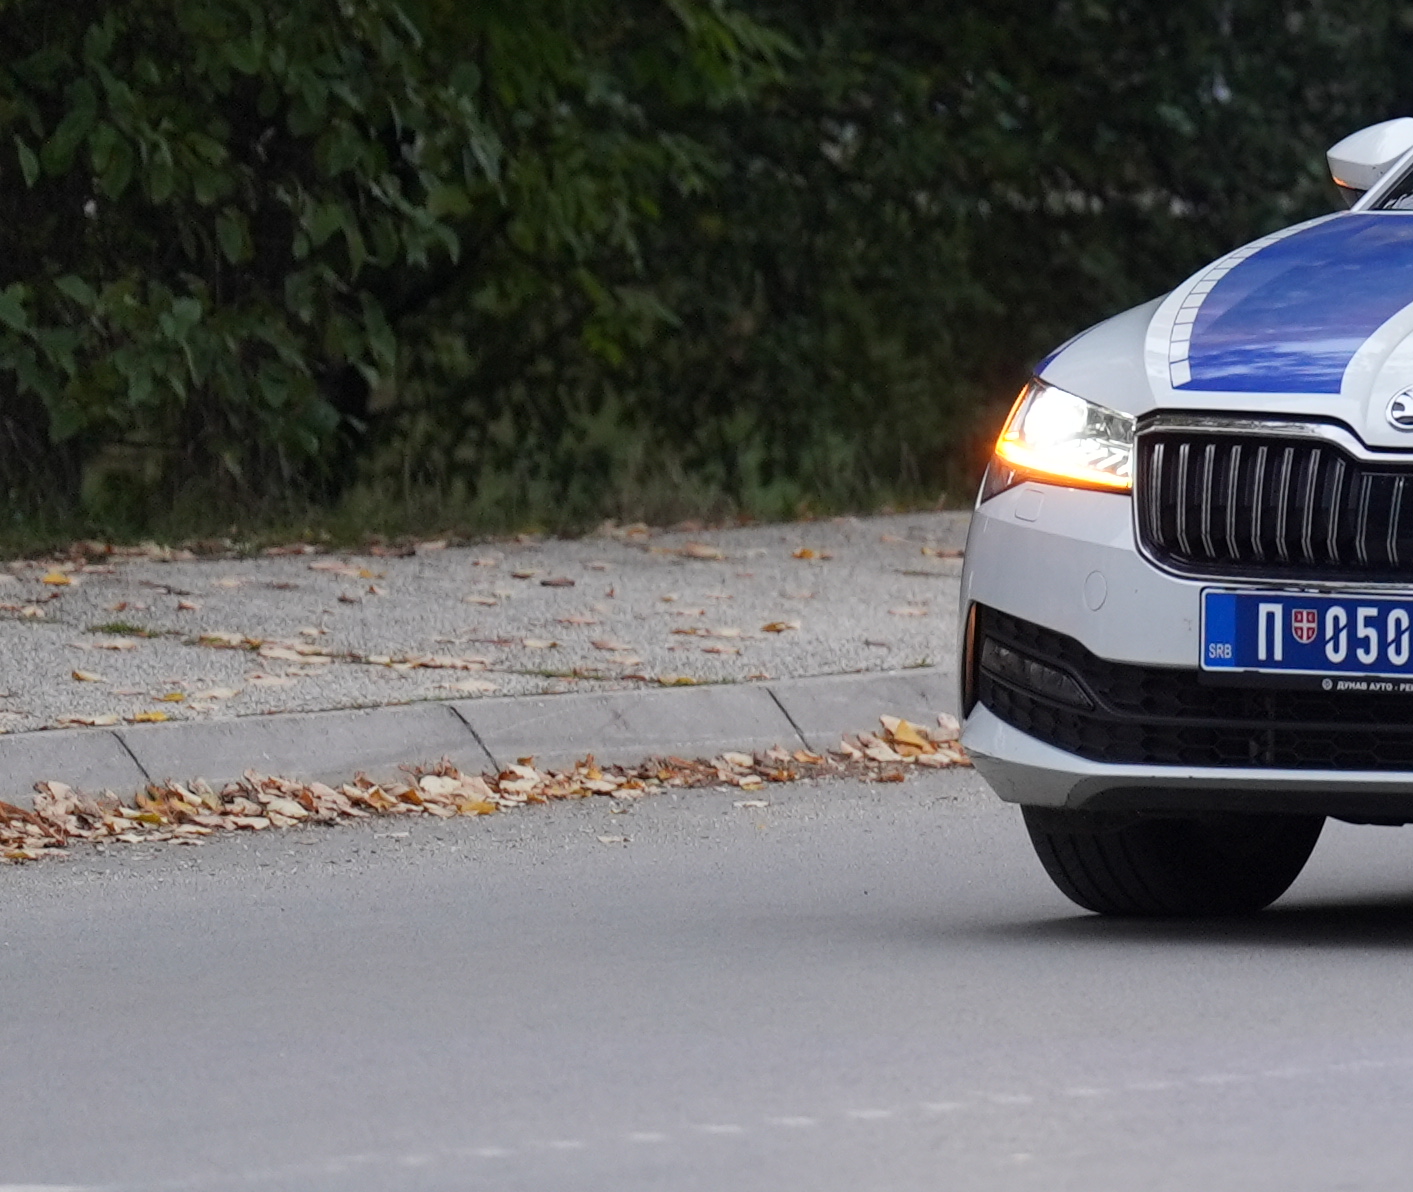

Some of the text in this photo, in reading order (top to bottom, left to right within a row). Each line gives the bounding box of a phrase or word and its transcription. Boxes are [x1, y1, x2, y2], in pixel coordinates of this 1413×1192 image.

[1257, 602, 1284, 662] П
[1208, 643, 1232, 659] SRB
[1369, 682, 1393, 691] АУТО
